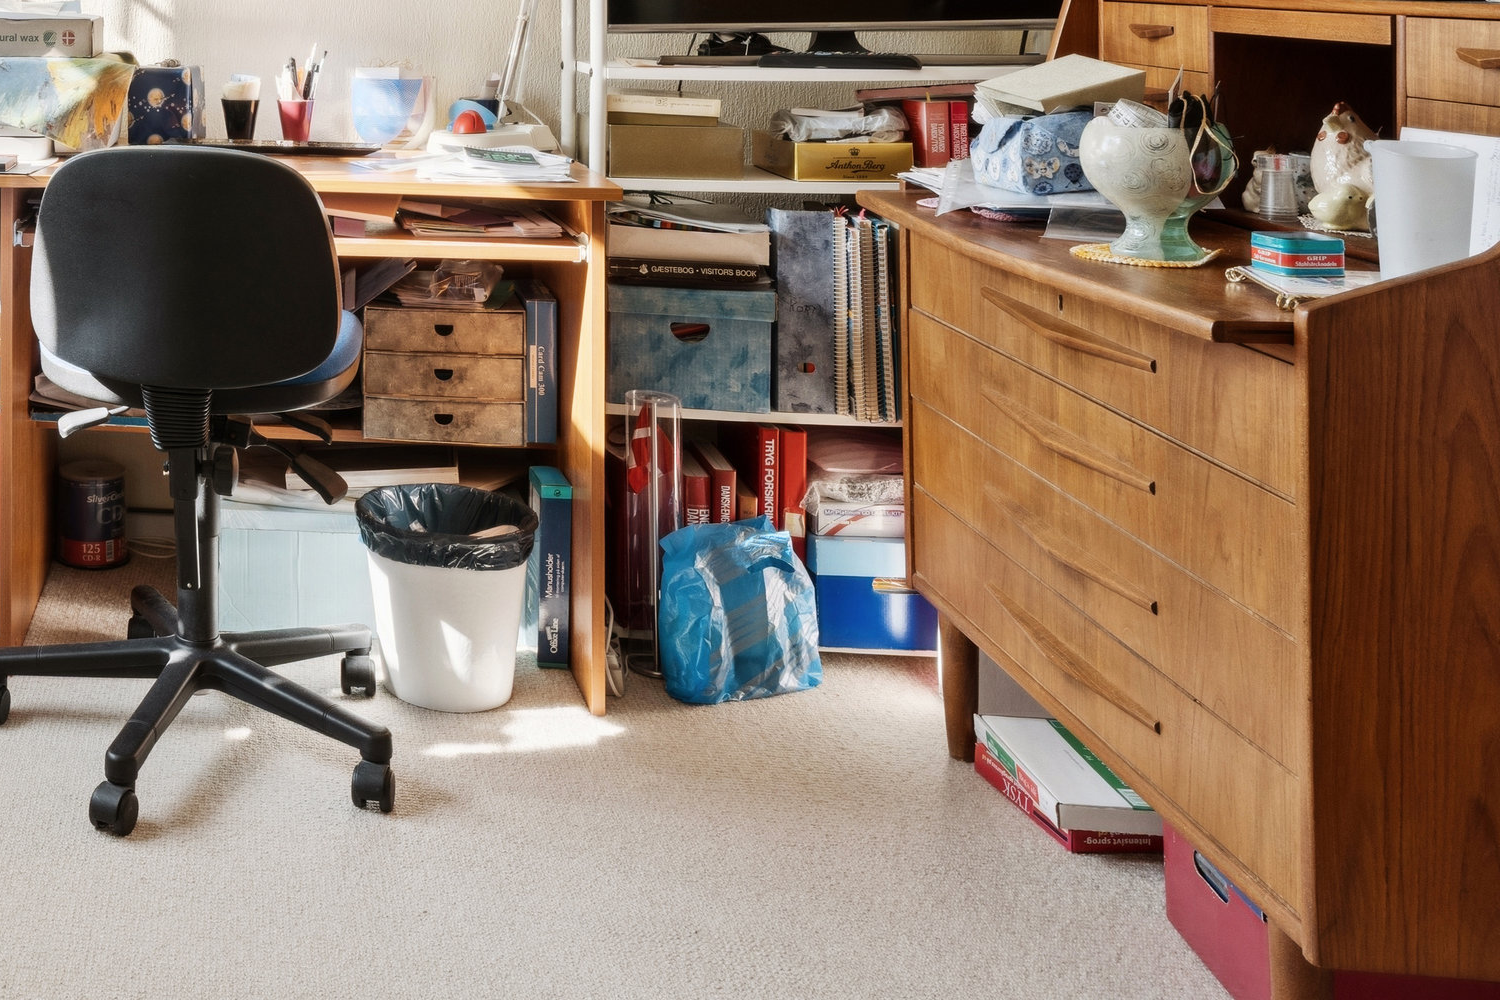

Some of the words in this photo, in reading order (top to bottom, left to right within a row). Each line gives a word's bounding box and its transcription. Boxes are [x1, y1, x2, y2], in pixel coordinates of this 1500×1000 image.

[825, 159, 862, 171] Anthon
[861, 159, 886, 171] Berg
[650, 265, 694, 274] GÆSTEBOG
[735, 268, 757, 277] BOOK
[537, 345, 546, 364] Card
[537, 382, 546, 396] 300
[764, 438, 775, 466] TRYG
[82, 543, 101, 554] 125
[82, 554, 101, 562] CD-R
[544, 552, 554, 599] Manusholder
[550, 617, 559, 633] Line
[549, 633, 558, 654] Office
[1002, 777, 1031, 815] TYSK
[1083, 836, 1111, 845] sprog-
[1113, 837, 1152, 847] Intensivt
